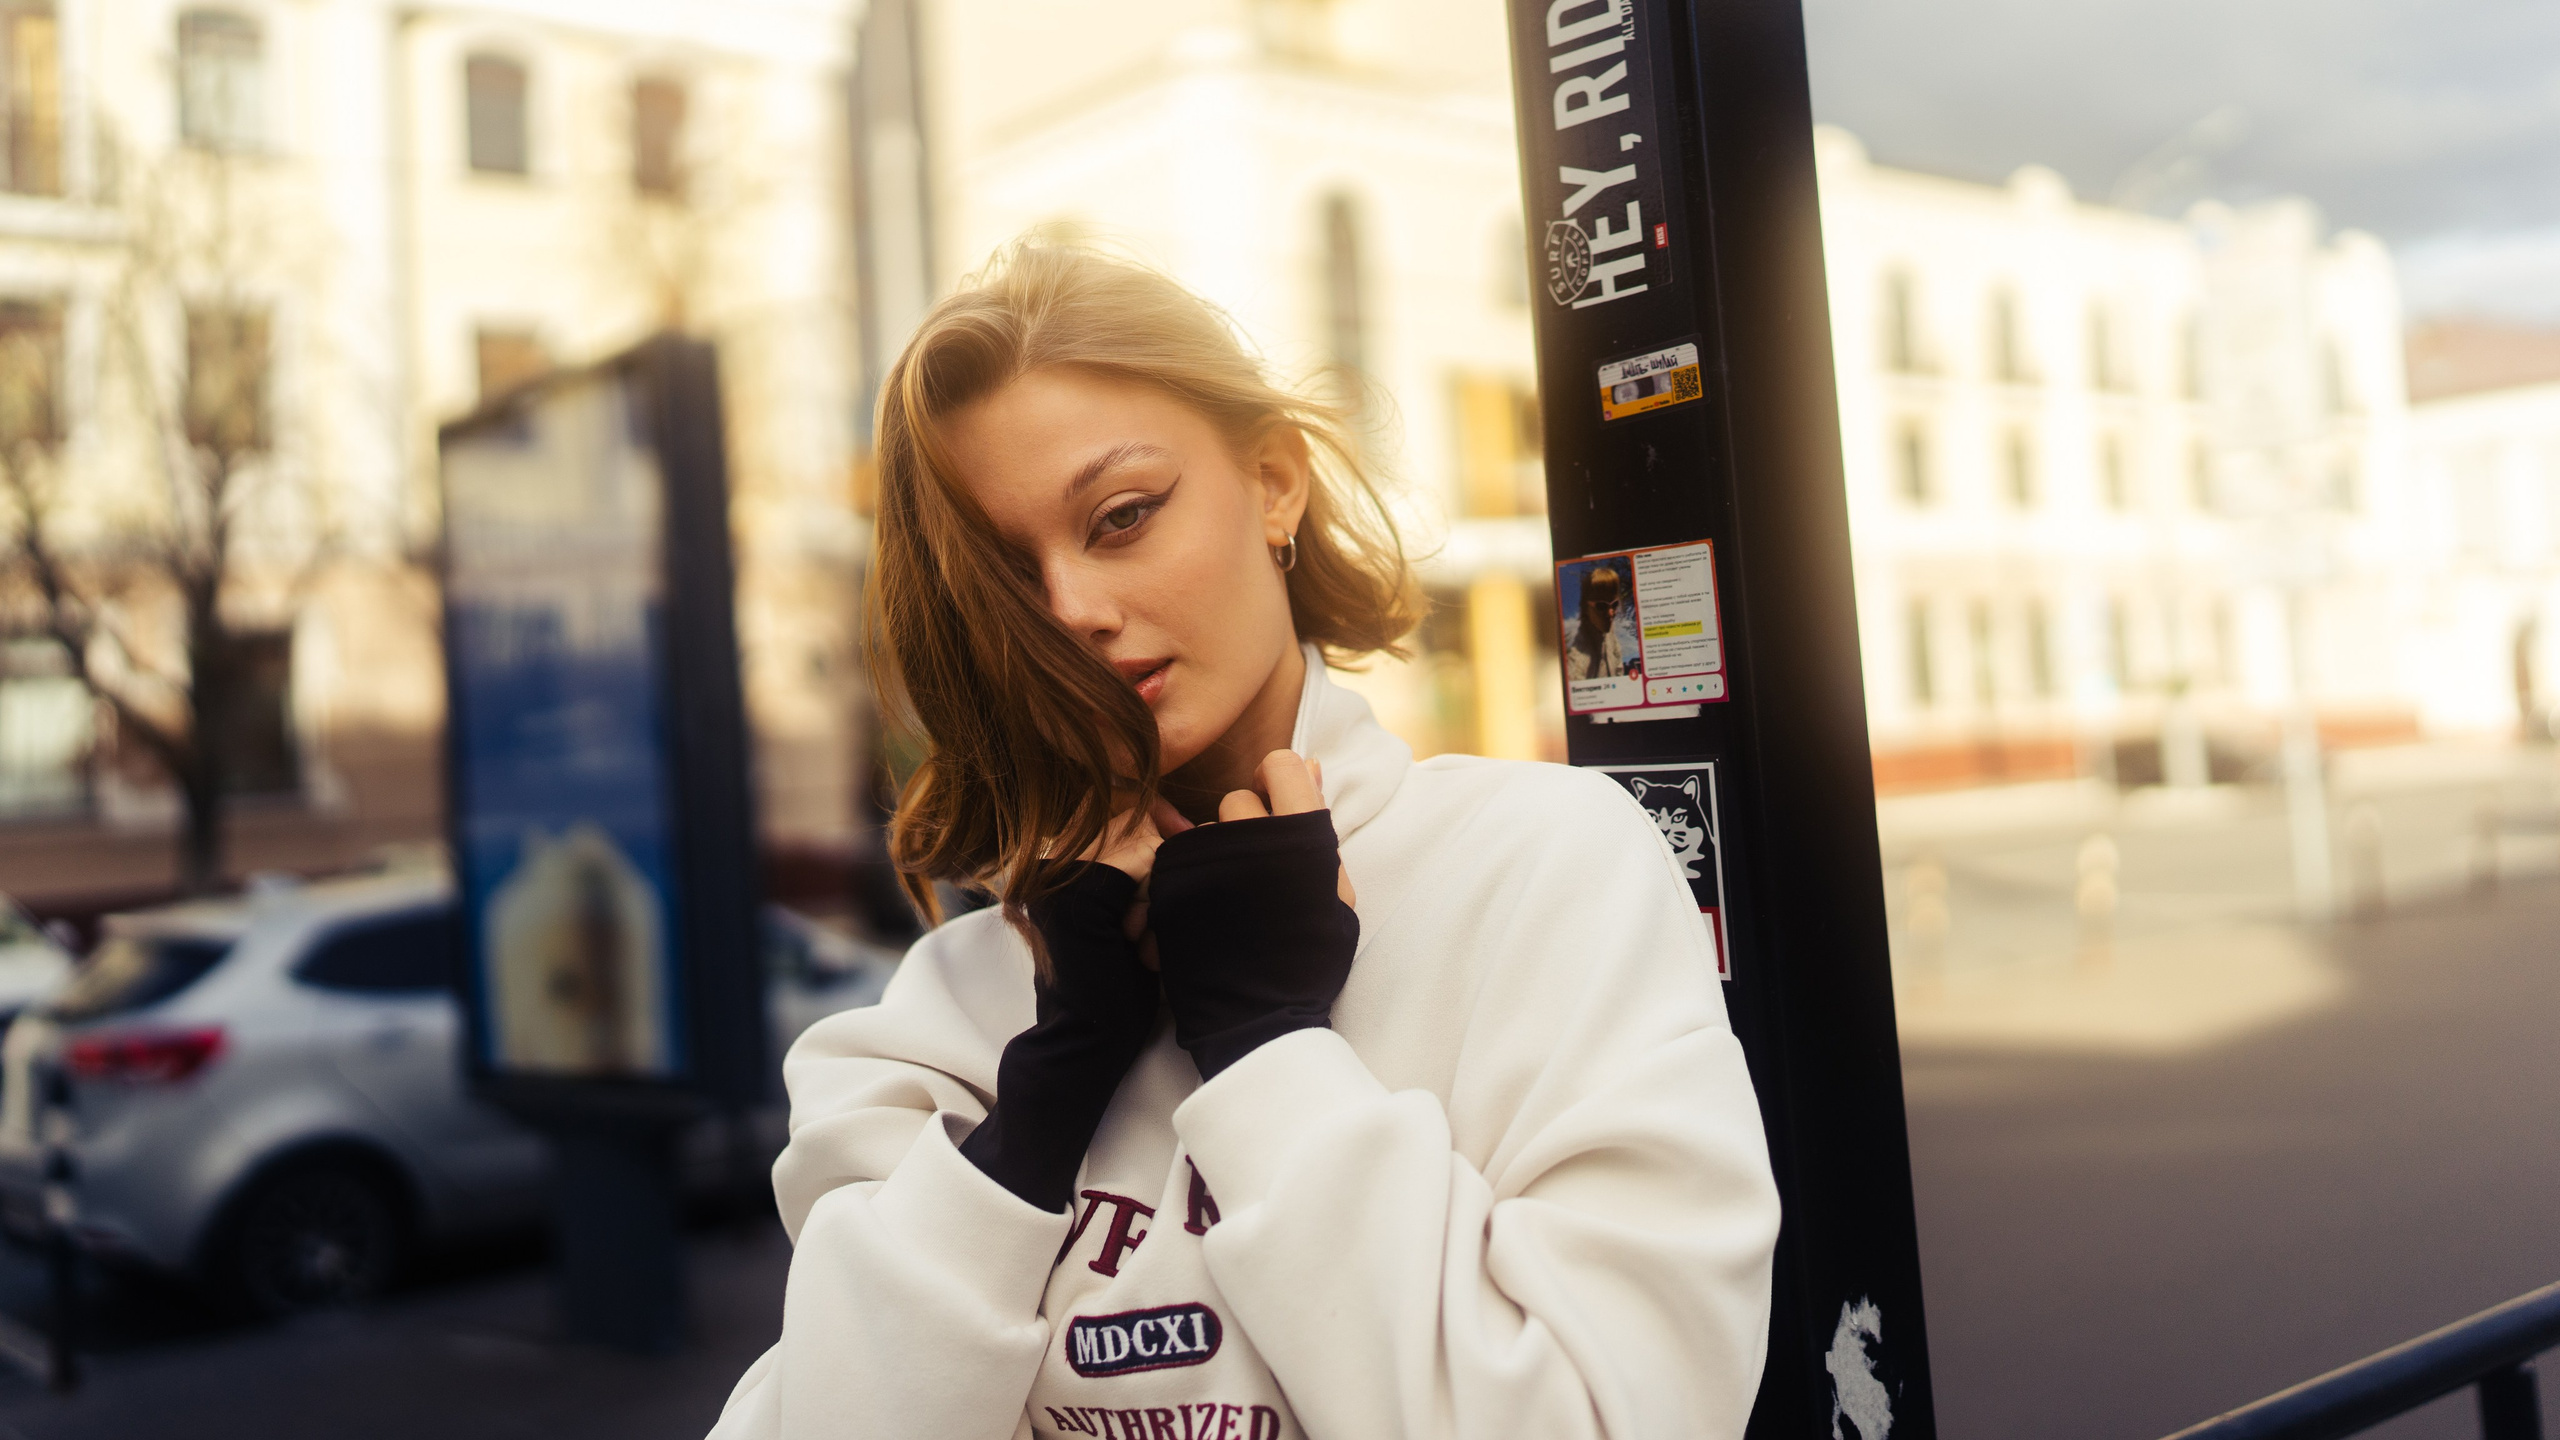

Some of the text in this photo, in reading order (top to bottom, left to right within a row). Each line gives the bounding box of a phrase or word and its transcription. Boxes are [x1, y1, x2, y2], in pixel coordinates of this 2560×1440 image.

[1620, 17, 1635, 40] ALL
[1559, 133, 1648, 310] HEY,
[1548, 233, 1567, 294] SURF
[1570, 229, 1589, 287] COFFEE
[1073, 1311, 1210, 1366] MDCXI
[1045, 1402, 1281, 1440] AUTHRIZED
